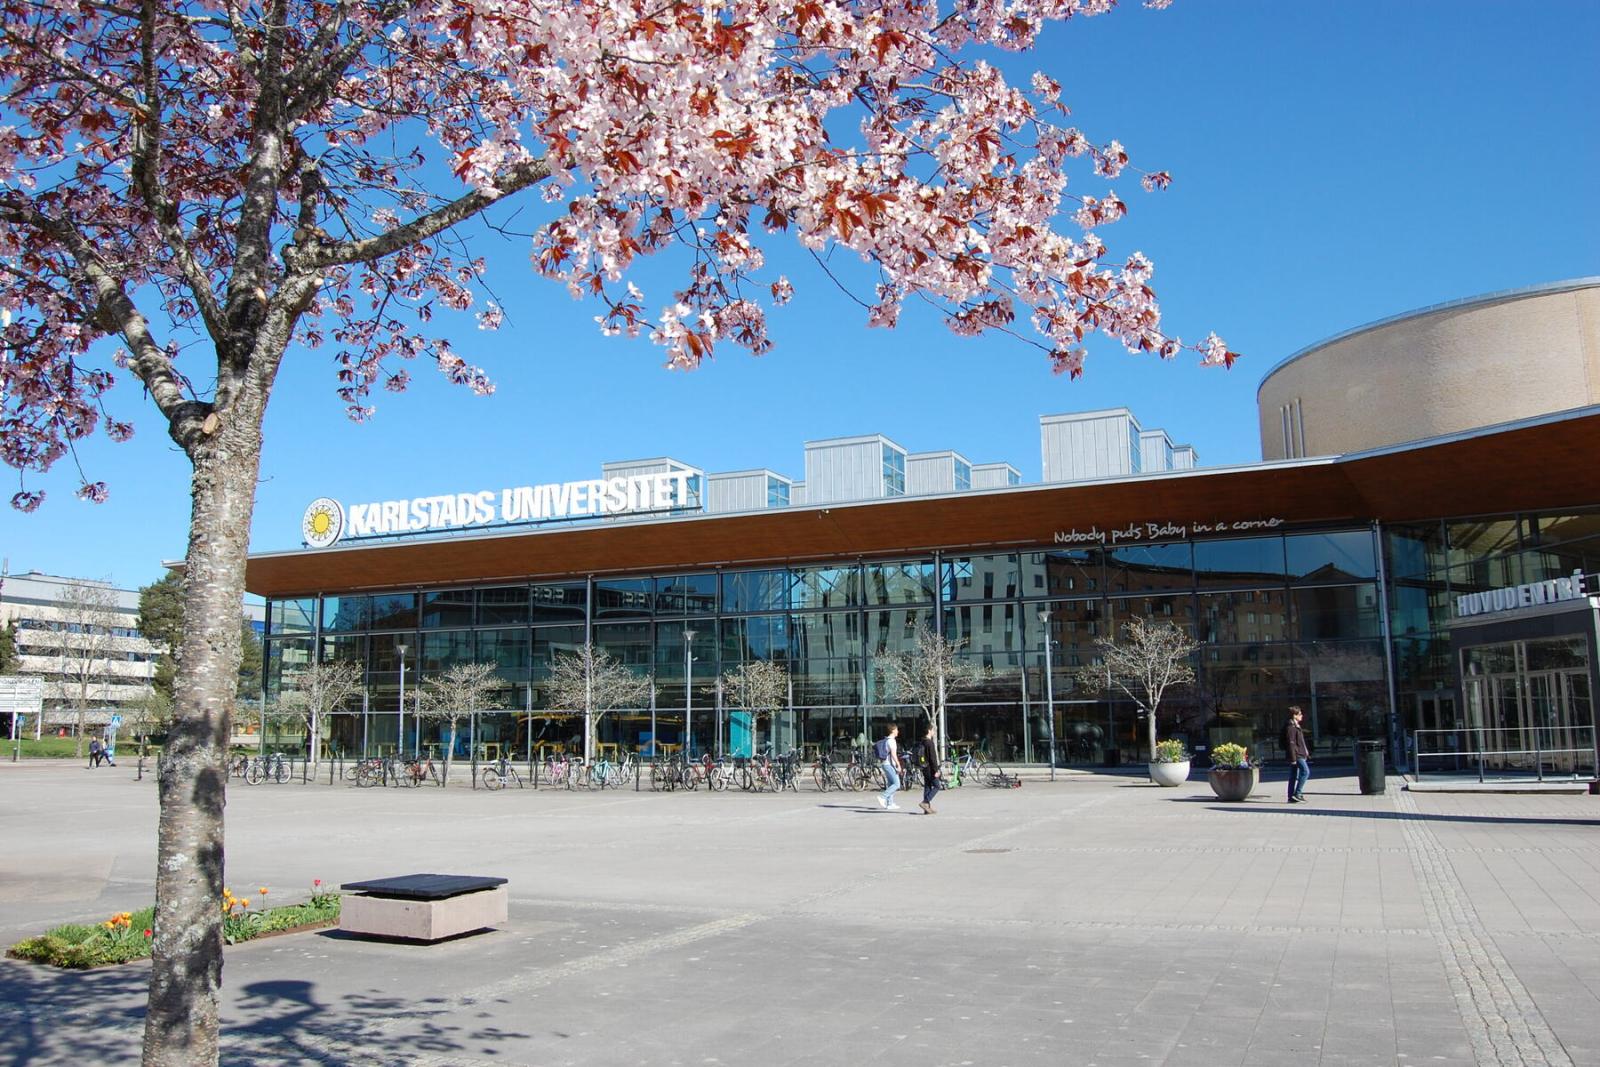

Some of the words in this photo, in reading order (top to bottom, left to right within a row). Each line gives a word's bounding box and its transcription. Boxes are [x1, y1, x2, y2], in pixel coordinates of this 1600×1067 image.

[349, 490, 496, 536] KARLSTADS
[502, 471, 693, 521] UNIVERSITET
[1054, 526, 1106, 544] Nobody
[1111, 523, 1142, 543] puts
[1146, 522, 1186, 540] Baby
[1193, 521, 1211, 533] in
[1215, 522, 1228, 531] a
[1232, 517, 1284, 529] corner
[1457, 568, 1587, 616] HUVUDENTRÉ
